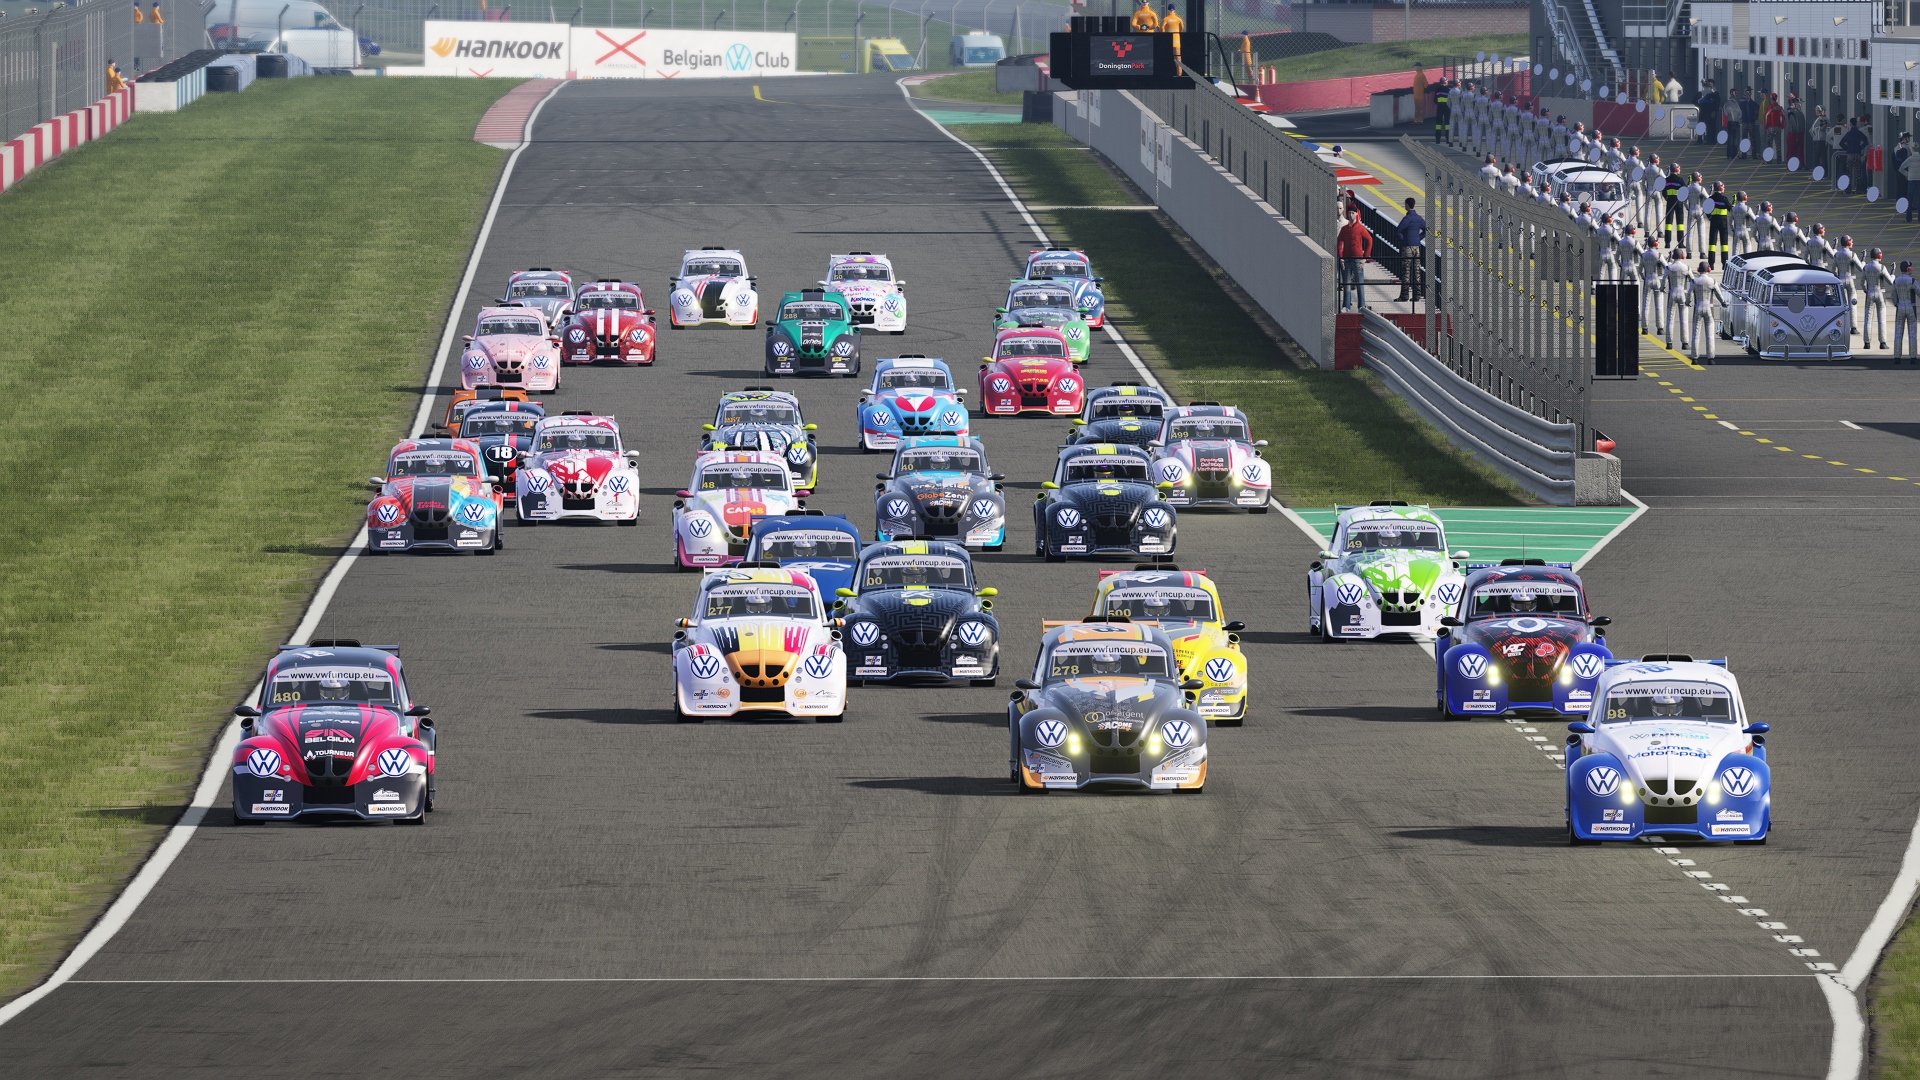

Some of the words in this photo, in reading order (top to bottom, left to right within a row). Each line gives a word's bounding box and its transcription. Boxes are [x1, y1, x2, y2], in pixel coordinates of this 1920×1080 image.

[663, 49, 722, 70] Belgian
[754, 52, 789, 68] Club
[491, 446, 512, 459] 18
[1078, 458, 1135, 466] www.vwfuncup.eu
[714, 466, 771, 474] www.vwfuncup.eu
[902, 463, 914, 471] 40
[726, 506, 764, 515] CAP48
[1360, 525, 1426, 533] www.vwfuncup.eu
[774, 533, 840, 542] www.vwfuncup.eu
[1348, 540, 1363, 548] 49
[881, 559, 950, 568] www.vwfuncup.eu
[867, 577, 882, 586] 00
[722, 588, 796, 597] www.vwfuncup.eu
[1122, 591, 1195, 600] www.vwfuncup.eu
[1489, 587, 1562, 596] www.vwfuncup.eu
[709, 606, 732, 616] 277
[1108, 608, 1131, 617] 500
[1069, 645, 1149, 655] www.vwfuncup.eu
[1054, 665, 1079, 676] 278
[291, 671, 374, 681] www.vwfuncup.eu
[273, 691, 301, 702] 480
[1625, 687, 1711, 697] www.vwfuncup.eu
[1607, 708, 1626, 719] 98
